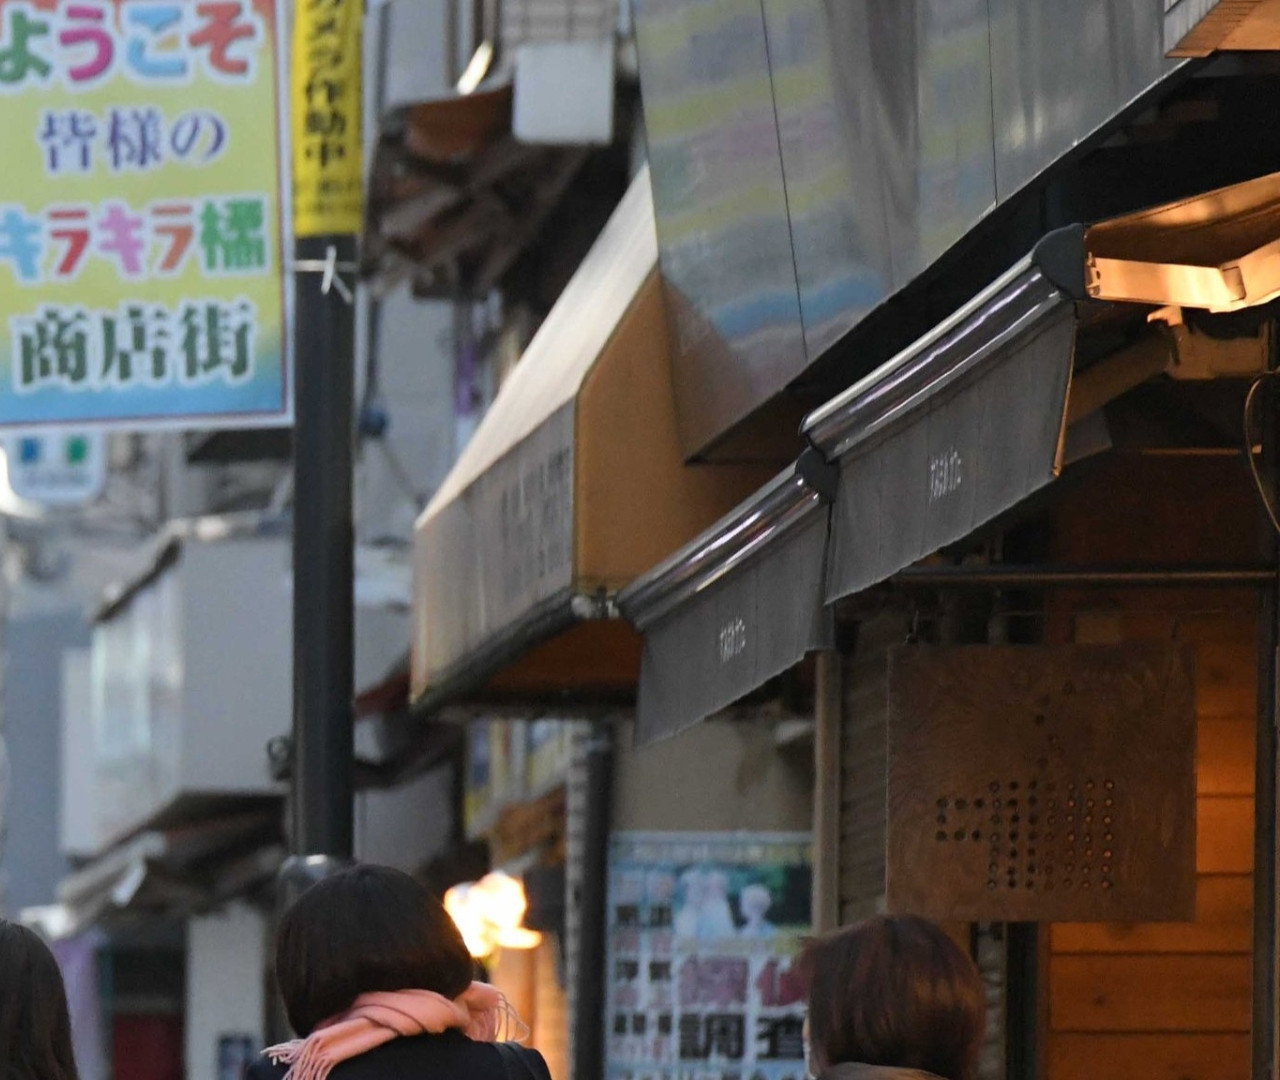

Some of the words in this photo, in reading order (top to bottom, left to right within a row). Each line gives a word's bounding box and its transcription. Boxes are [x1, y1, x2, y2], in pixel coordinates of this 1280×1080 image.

[40, 108, 227, 171] 皆様の
[19, 304, 253, 385] 商店街
